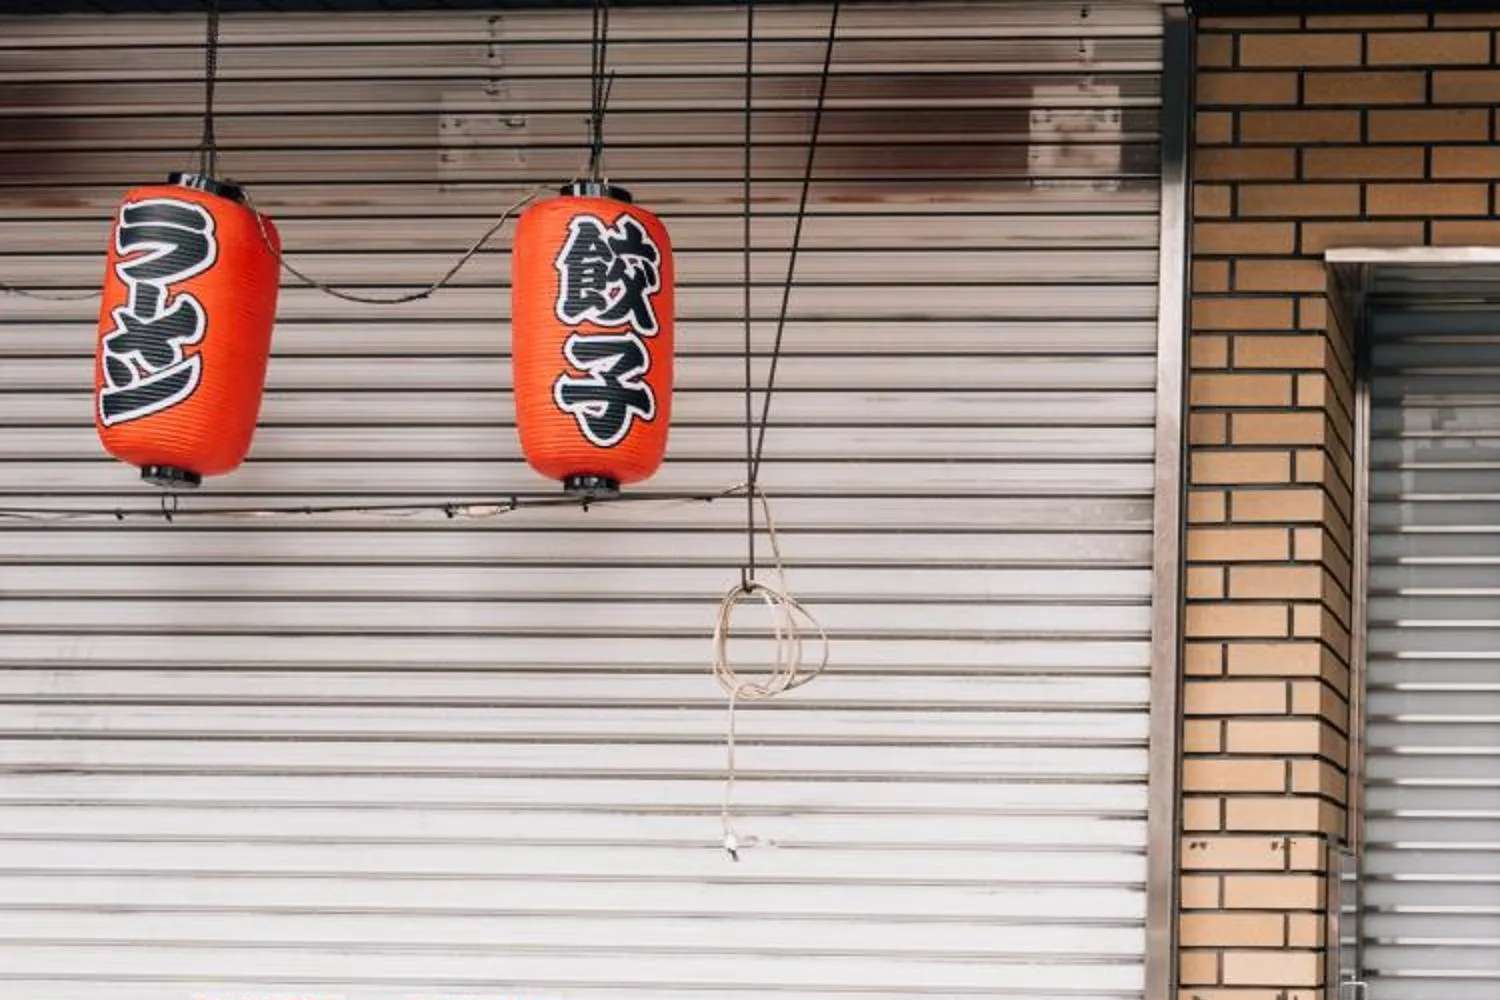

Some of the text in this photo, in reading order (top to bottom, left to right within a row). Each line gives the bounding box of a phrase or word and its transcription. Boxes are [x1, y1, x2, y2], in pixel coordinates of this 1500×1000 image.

[100, 199, 218, 426] ラーメン
[554, 214, 660, 447] 餃子
